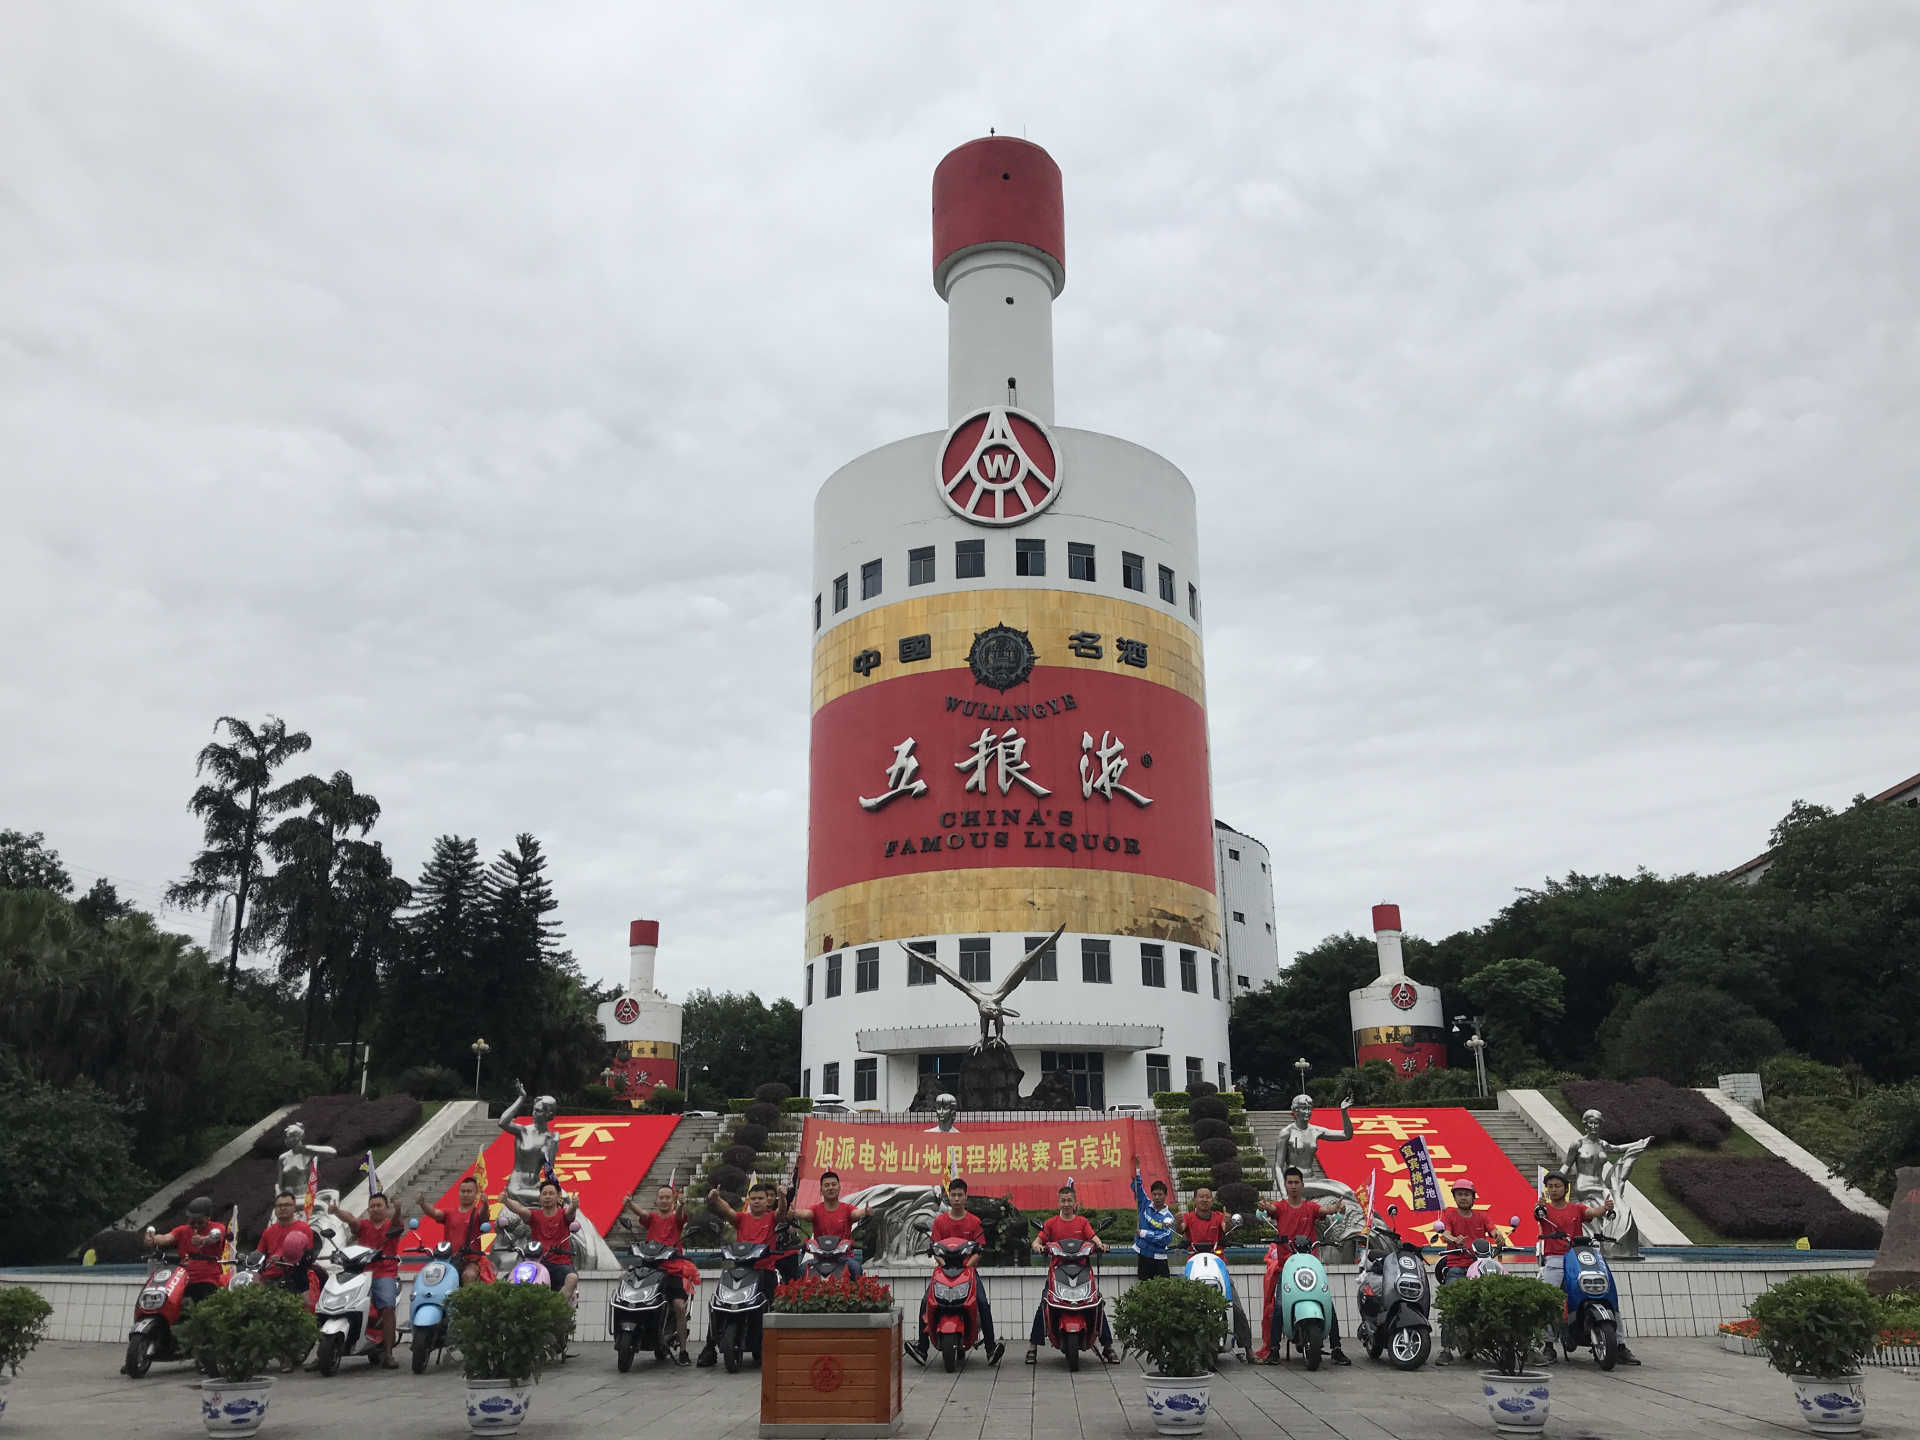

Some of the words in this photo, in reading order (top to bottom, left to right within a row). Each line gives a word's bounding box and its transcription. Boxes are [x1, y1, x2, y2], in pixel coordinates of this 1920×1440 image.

[982, 454, 1016, 480] W
[1068, 631, 1149, 669] 名酒
[945, 694, 1078, 721] WULIANGYE
[858, 727, 1154, 811] 五粮液
[939, 809, 1074, 828] CHINA'S
[884, 832, 1010, 858] FAMOUS
[1024, 831, 1141, 855] LIQUOR
